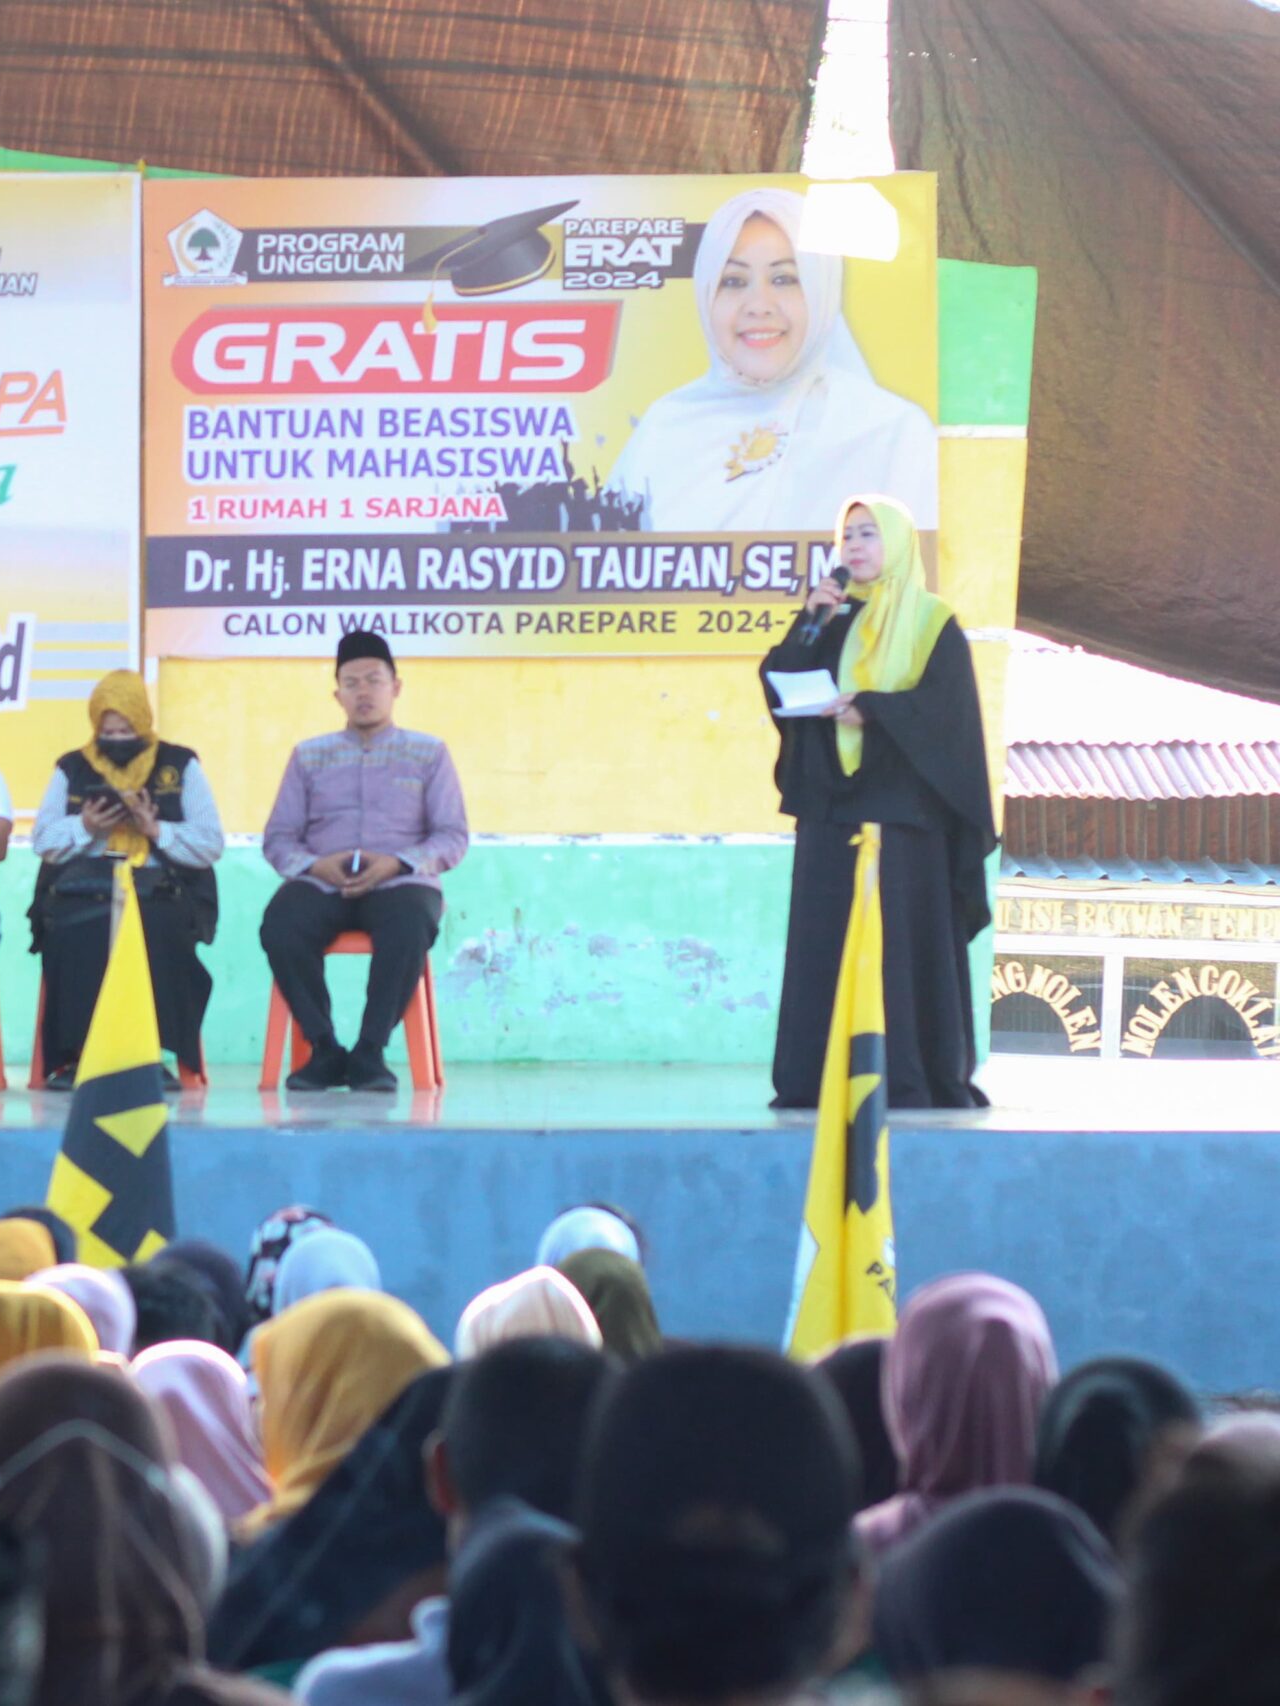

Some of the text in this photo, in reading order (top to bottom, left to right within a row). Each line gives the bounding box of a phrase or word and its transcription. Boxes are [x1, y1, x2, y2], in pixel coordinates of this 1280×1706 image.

[565, 219, 684, 235] PAREPARE
[256, 232, 406, 253] PROGRAM
[564, 236, 684, 267] ERAT
[256, 253, 405, 274] UNGGULAN
[564, 271, 662, 288] 2024
[192, 318, 587, 384] GRATIS
[187, 406, 574, 440] BANTUAN BEASISWA
[187, 446, 561, 480] UNTUK MAHASISWA
[192, 497, 503, 519] 1 RUMAH 1 SARJANA
[184, 549, 235, 592] Dr.
[245, 548, 291, 599] Hj.
[301, 547, 407, 591] ERNA
[417, 546, 566, 590] RASYID
[575, 545, 735, 592] TAUFAN,
[743, 545, 798, 592] SE,
[223, 611, 327, 637] CALON
[337, 610, 505, 636] WALIKOTA
[515, 609, 678, 635] PAREPARE
